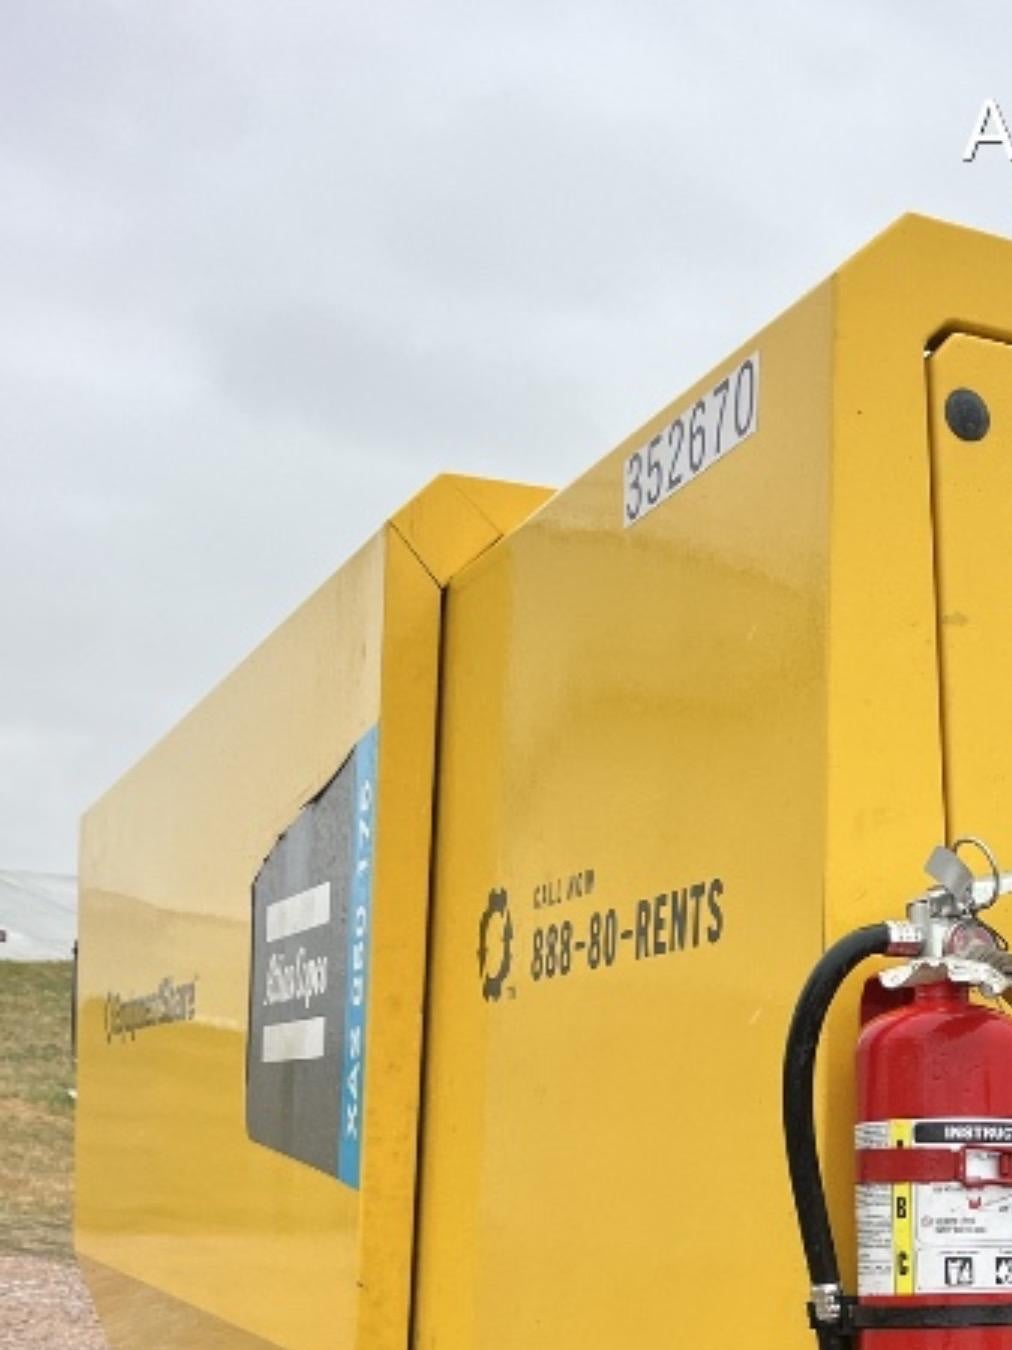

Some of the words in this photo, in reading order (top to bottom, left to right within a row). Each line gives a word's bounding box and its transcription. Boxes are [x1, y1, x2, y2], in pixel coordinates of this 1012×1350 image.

[626, 358, 755, 521] 352670
[530, 877, 724, 982] 888-80-RENTS
[896, 1196, 907, 1218] B
